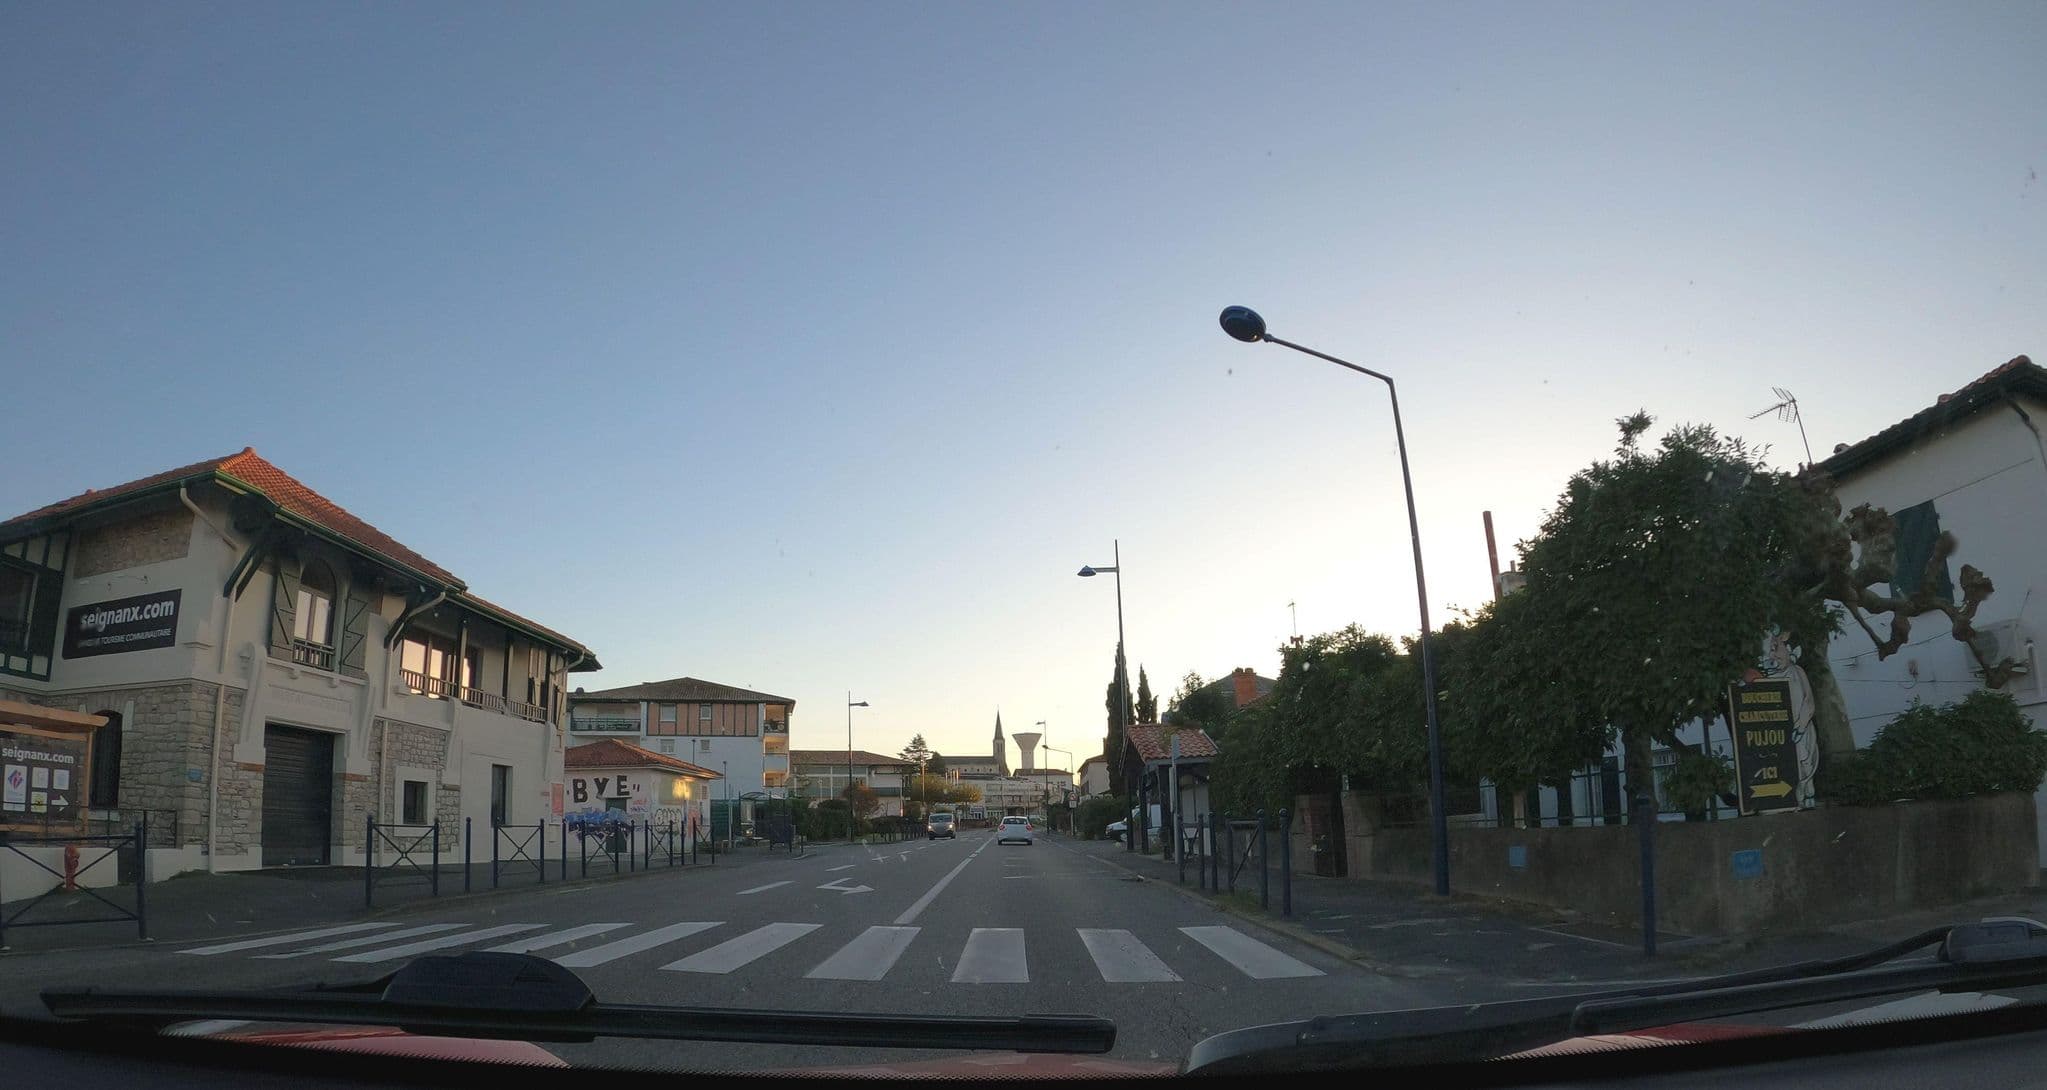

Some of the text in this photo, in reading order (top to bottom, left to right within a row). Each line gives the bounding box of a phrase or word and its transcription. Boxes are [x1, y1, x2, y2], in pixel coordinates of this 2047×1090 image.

[81, 600, 174, 632] seignanx.com
[1746, 730, 1785, 747] PUJOU
[2, 746, 74, 764] seignanx.com
[1762, 767, 1778, 779] ICI
